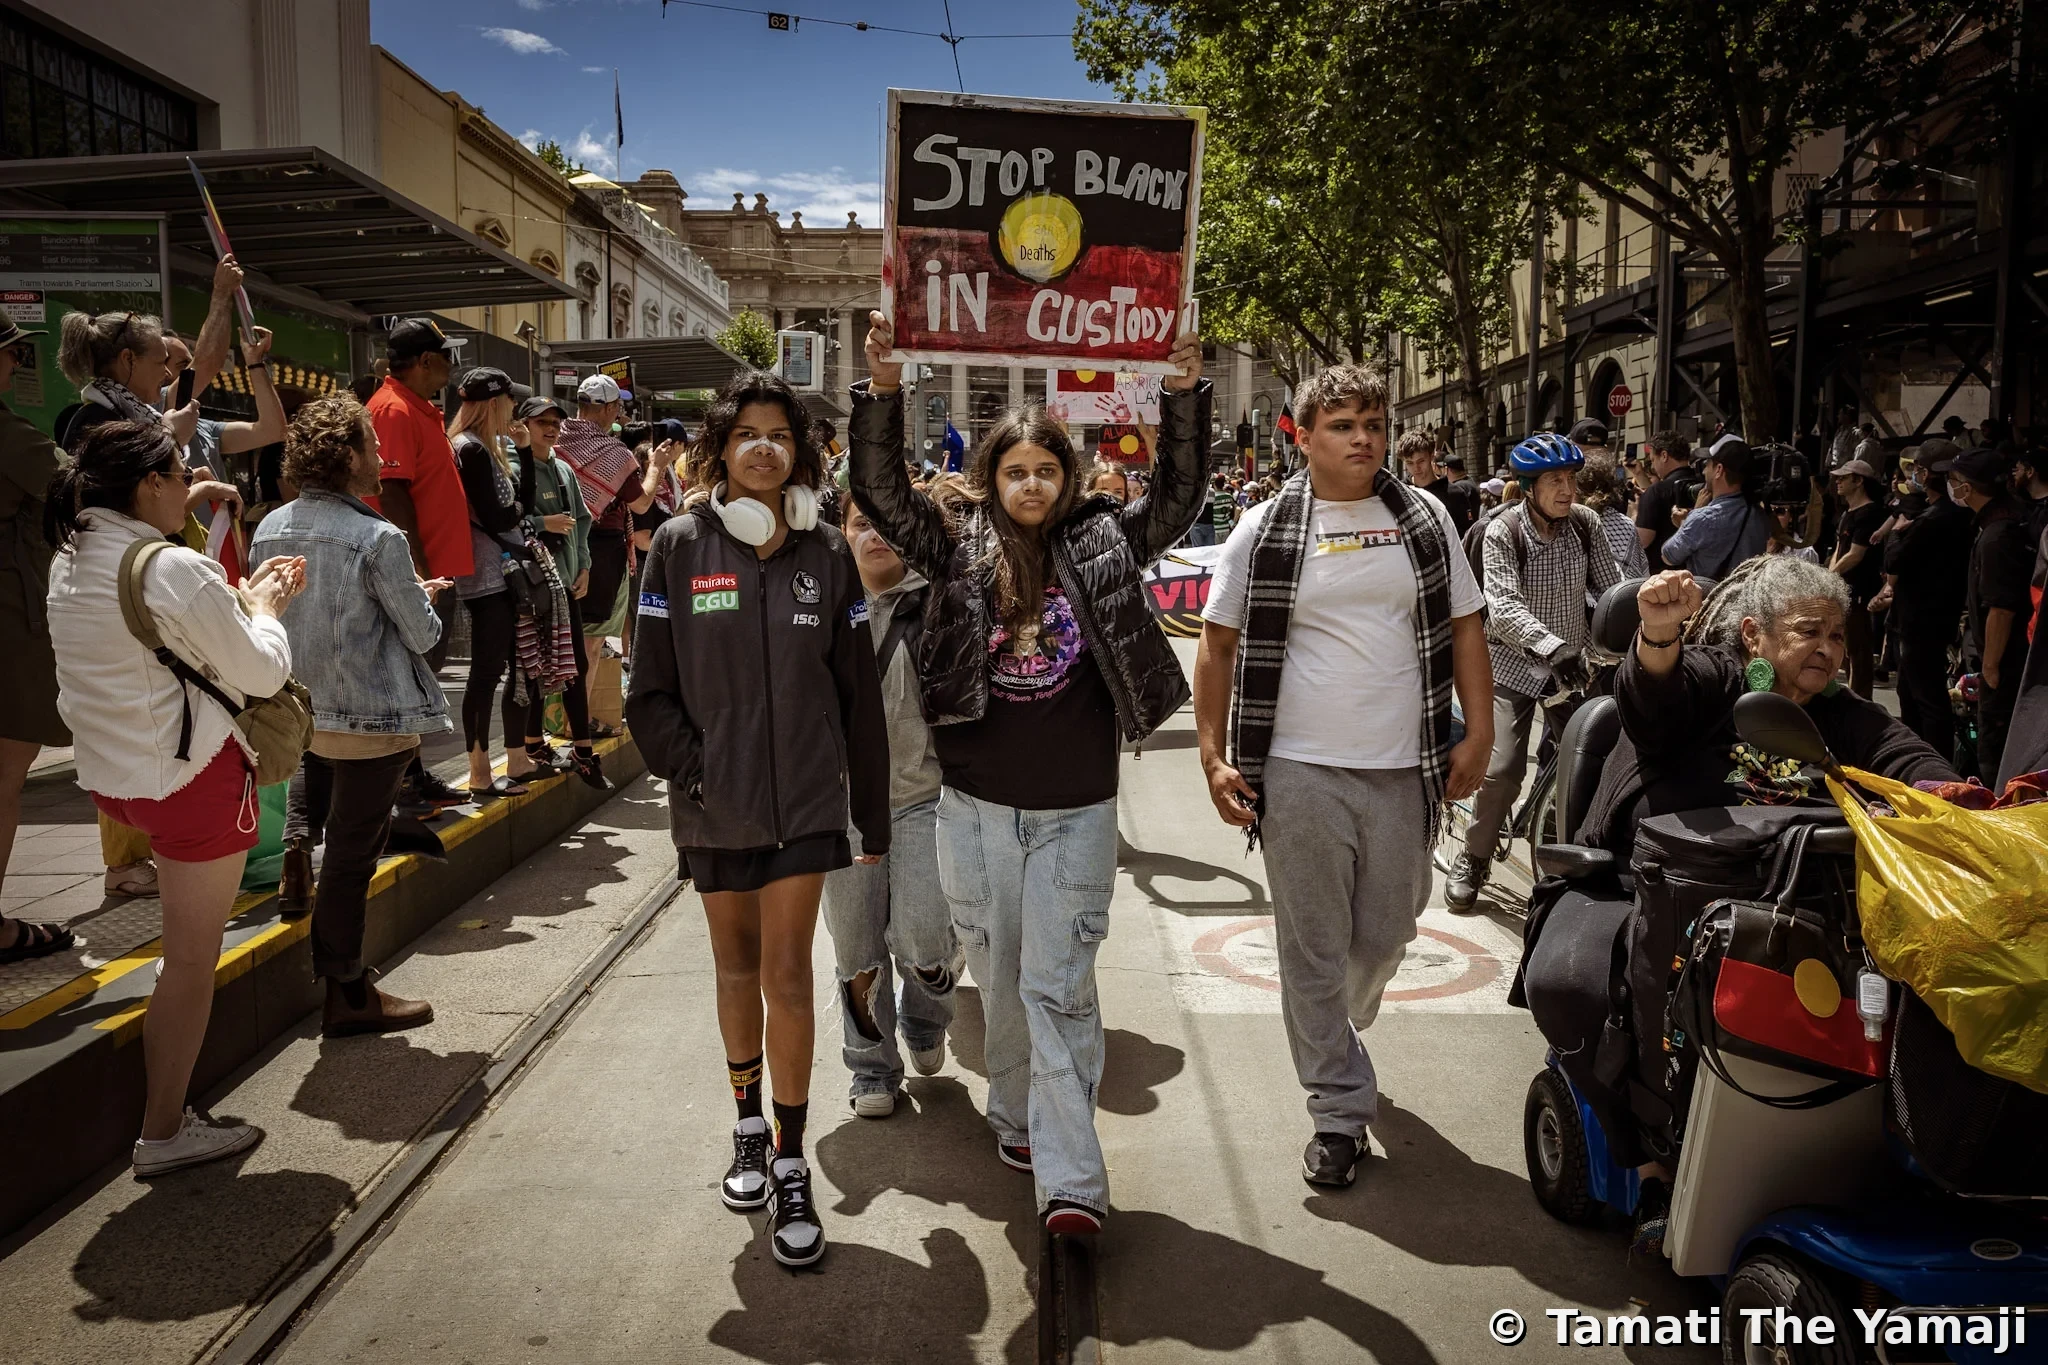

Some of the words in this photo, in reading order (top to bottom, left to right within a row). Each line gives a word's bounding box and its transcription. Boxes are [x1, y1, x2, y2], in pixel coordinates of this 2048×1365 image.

[771, 16, 787, 28] 62
[913, 133, 1055, 211] STOP
[1075, 150, 1188, 210] BLACK
[1021, 244, 1057, 261] Deaths
[42, 256, 60, 264] East
[61, 256, 100, 264] Brunswick
[43, 280, 73, 288] towards
[75, 280, 114, 289] Parliament
[116, 280, 142, 289] Station
[1026, 286, 1175, 347] CUSTODY
[1609, 394, 1632, 407] STOP
[1103, 425, 1137, 441] ALWAYS
[692, 577, 736, 590] Emirates
[640, 594, 651, 605] La
[694, 592, 736, 611] CGU
